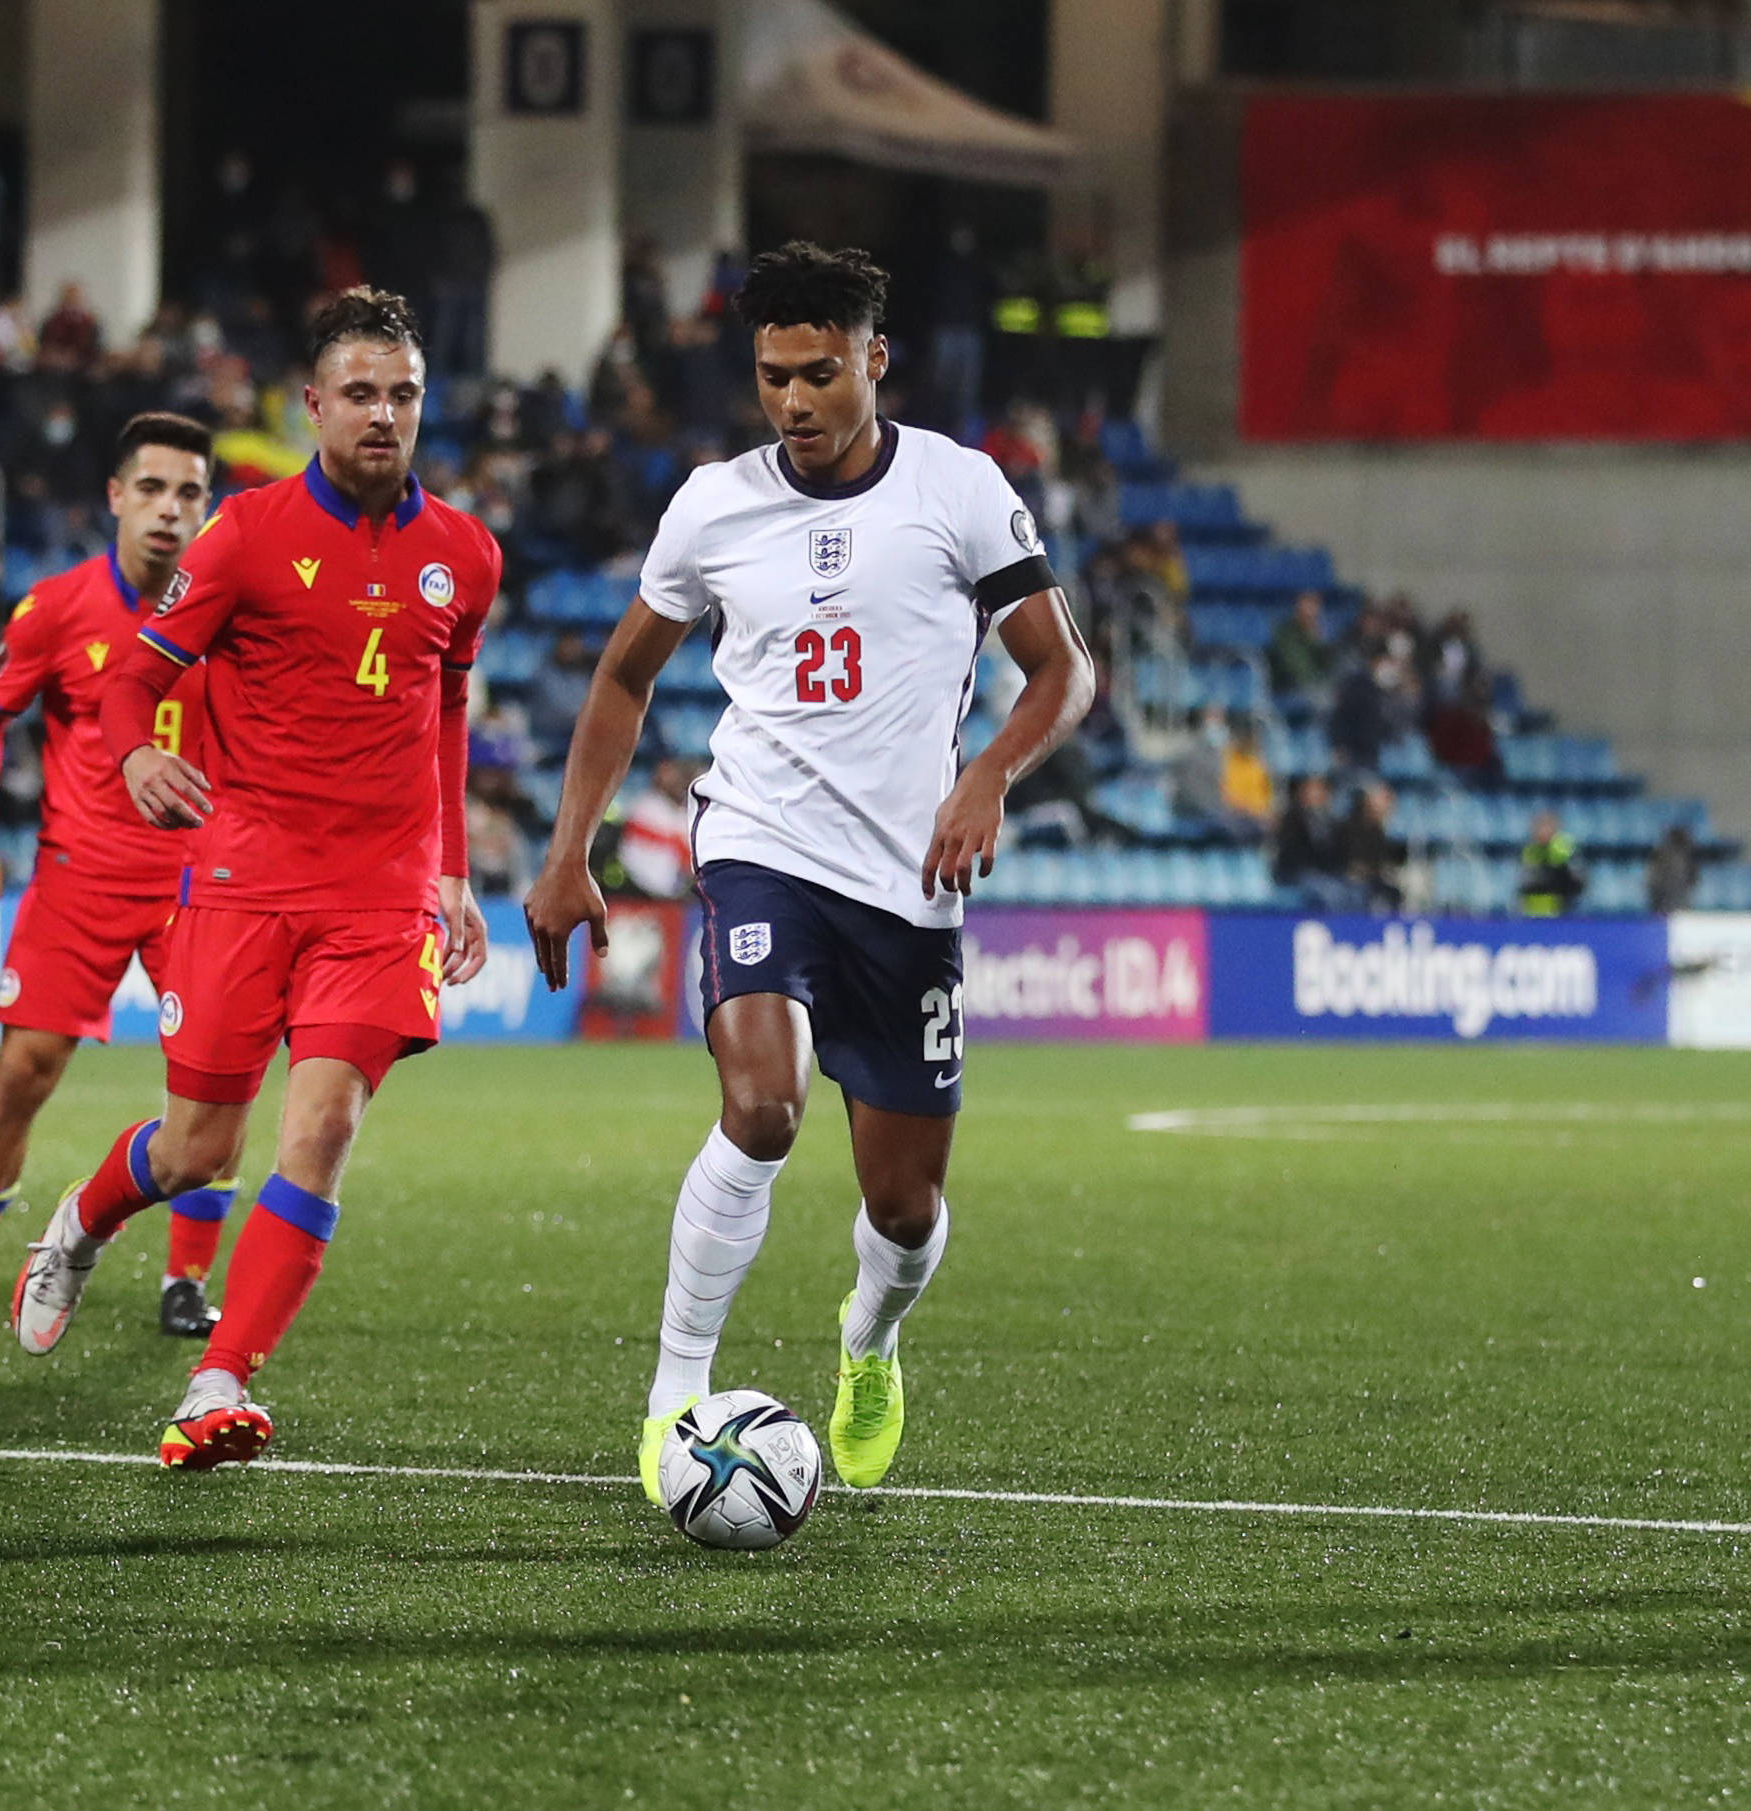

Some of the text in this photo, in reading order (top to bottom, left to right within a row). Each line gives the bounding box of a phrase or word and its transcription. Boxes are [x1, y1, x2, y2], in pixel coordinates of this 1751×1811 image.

[356, 627, 390, 696] 4
[794, 626, 863, 703] 23
[419, 932, 444, 988] 4
[961, 934, 1099, 1020] lectric
[1293, 919, 1598, 1039] Booking.com
